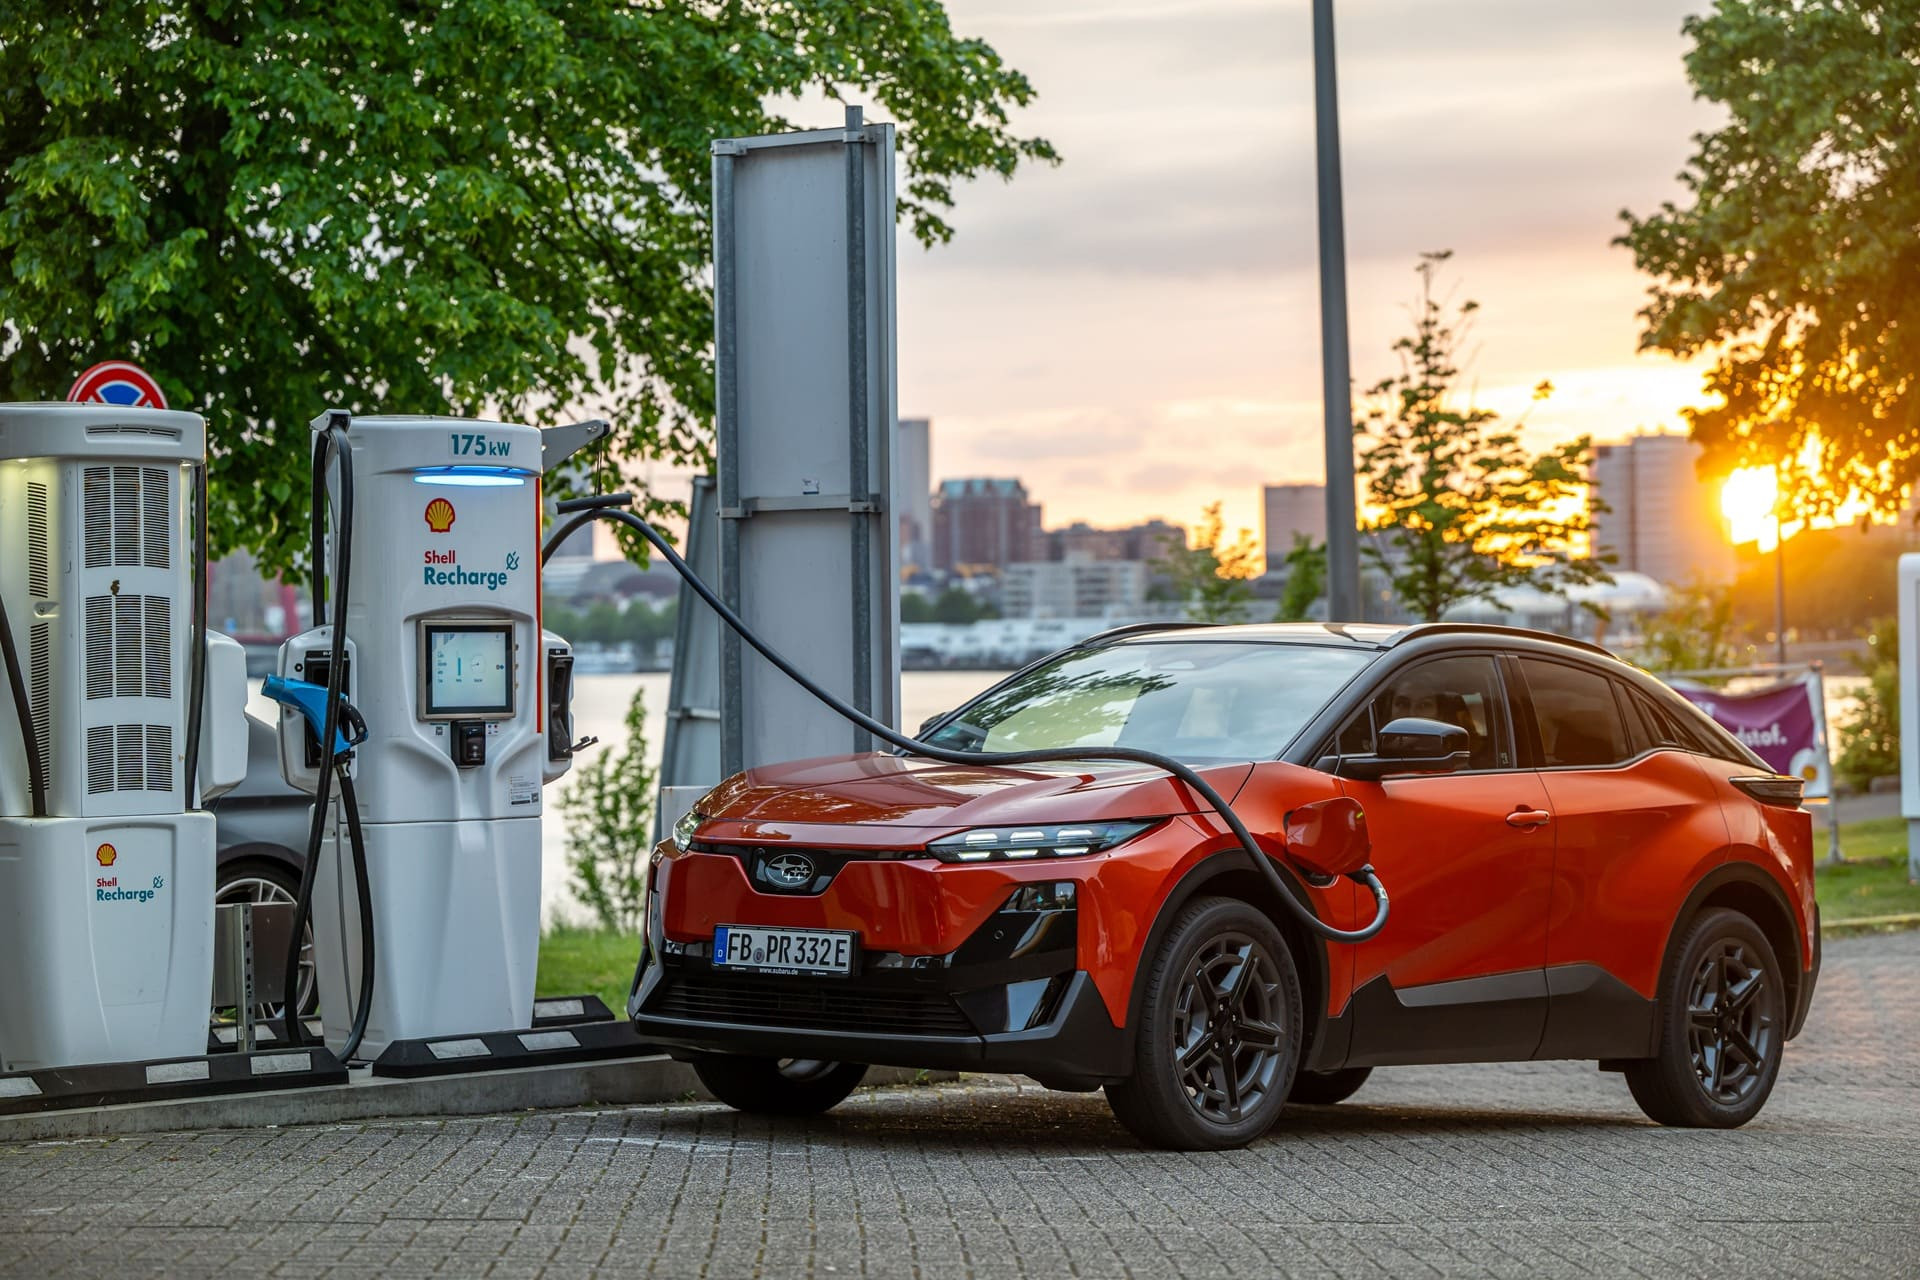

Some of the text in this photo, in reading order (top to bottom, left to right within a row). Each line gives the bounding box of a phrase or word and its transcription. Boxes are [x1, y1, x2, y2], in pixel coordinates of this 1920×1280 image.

[451, 434, 511, 456] 175 kW
[424, 550, 456, 564] Shell
[424, 565, 508, 591] Recharge
[96, 877, 118, 888] Shell
[96, 887, 154, 903] Recharge
[727, 932, 753, 961] FB
[765, 934, 792, 964] PR
[759, 966, 799, 976] www.subaru.de
